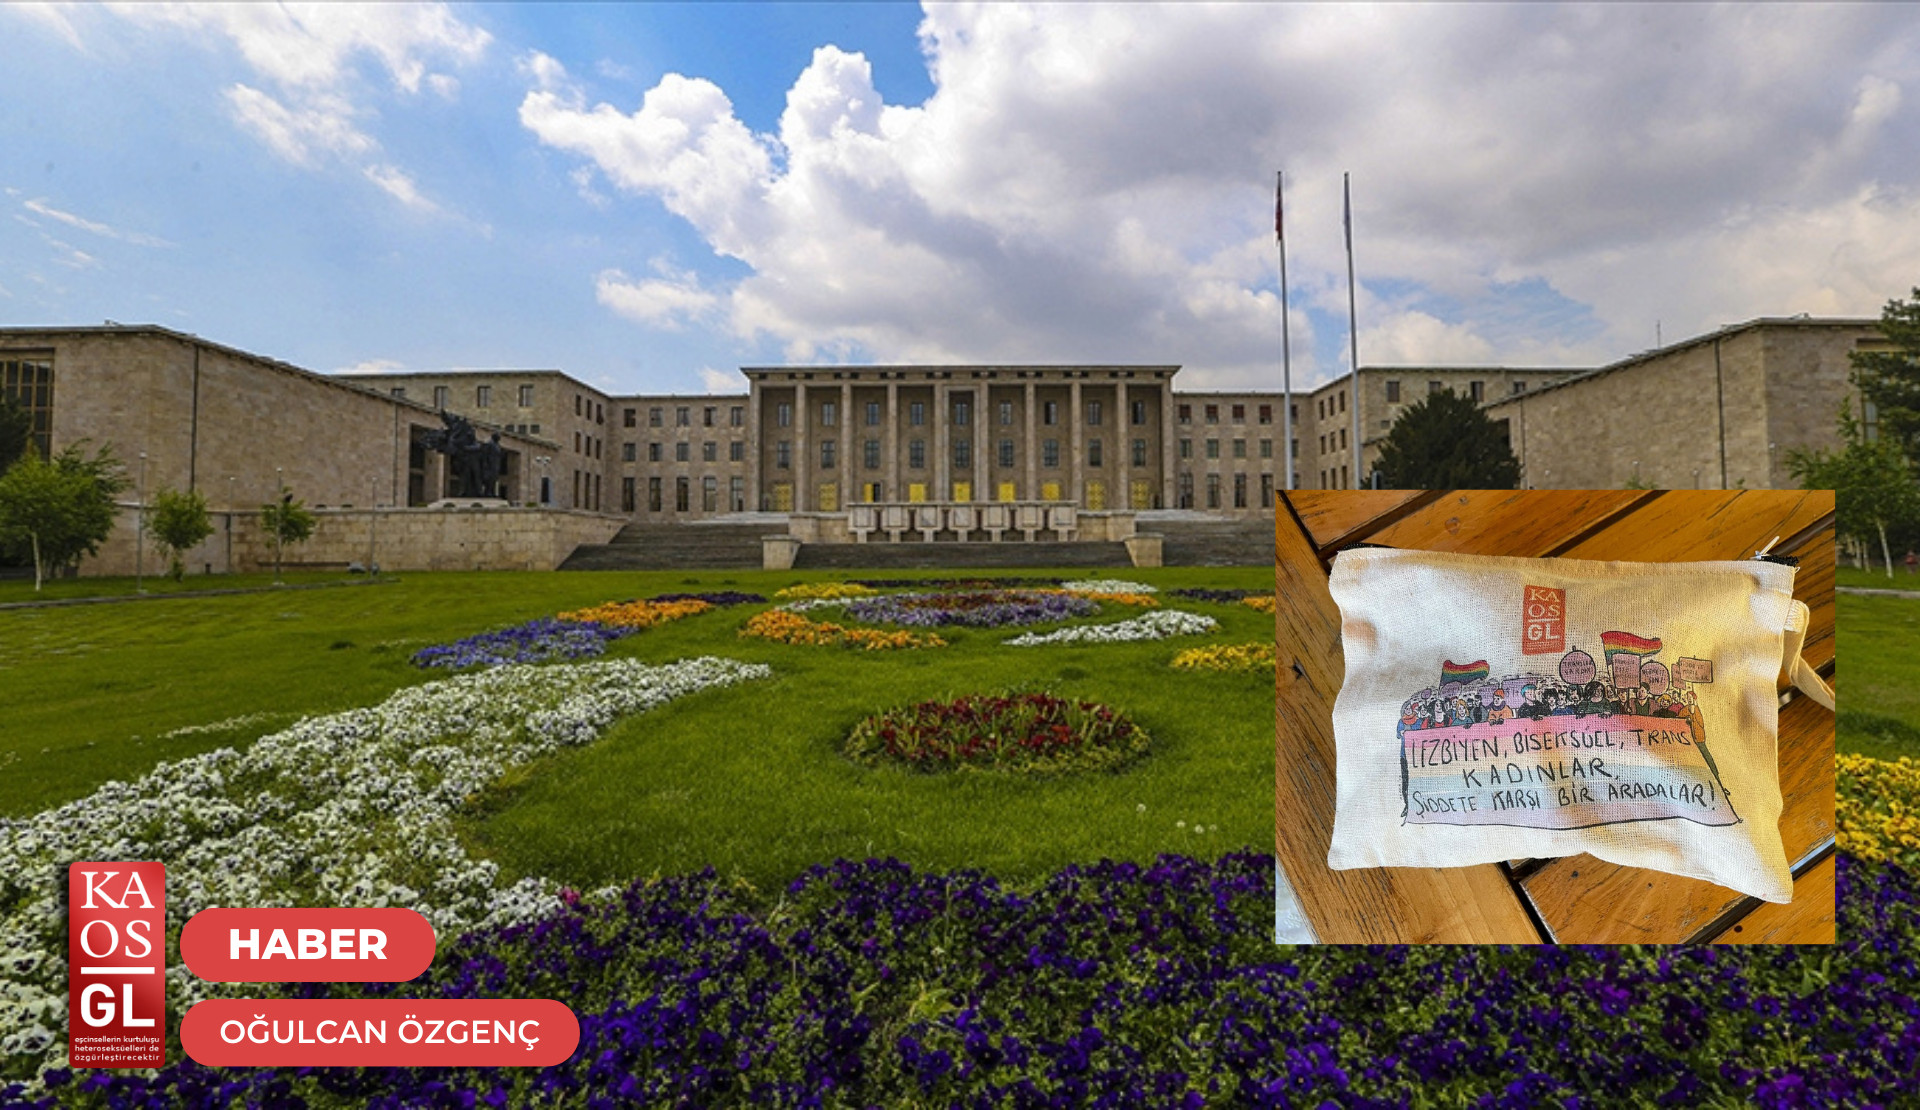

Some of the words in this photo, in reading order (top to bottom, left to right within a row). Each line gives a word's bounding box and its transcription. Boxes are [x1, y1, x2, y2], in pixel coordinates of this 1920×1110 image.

[1529, 588, 1560, 603] KA
[1528, 603, 1560, 618] OS
[1527, 623, 1560, 641] GL
[1629, 729, 1691, 746] TRANS
[1462, 757, 1619, 788] KADINLAR,
[1491, 789, 1541, 811] KARŞI
[1558, 782, 1595, 807] BİR
[1608, 780, 1716, 811] ARADALAR!
